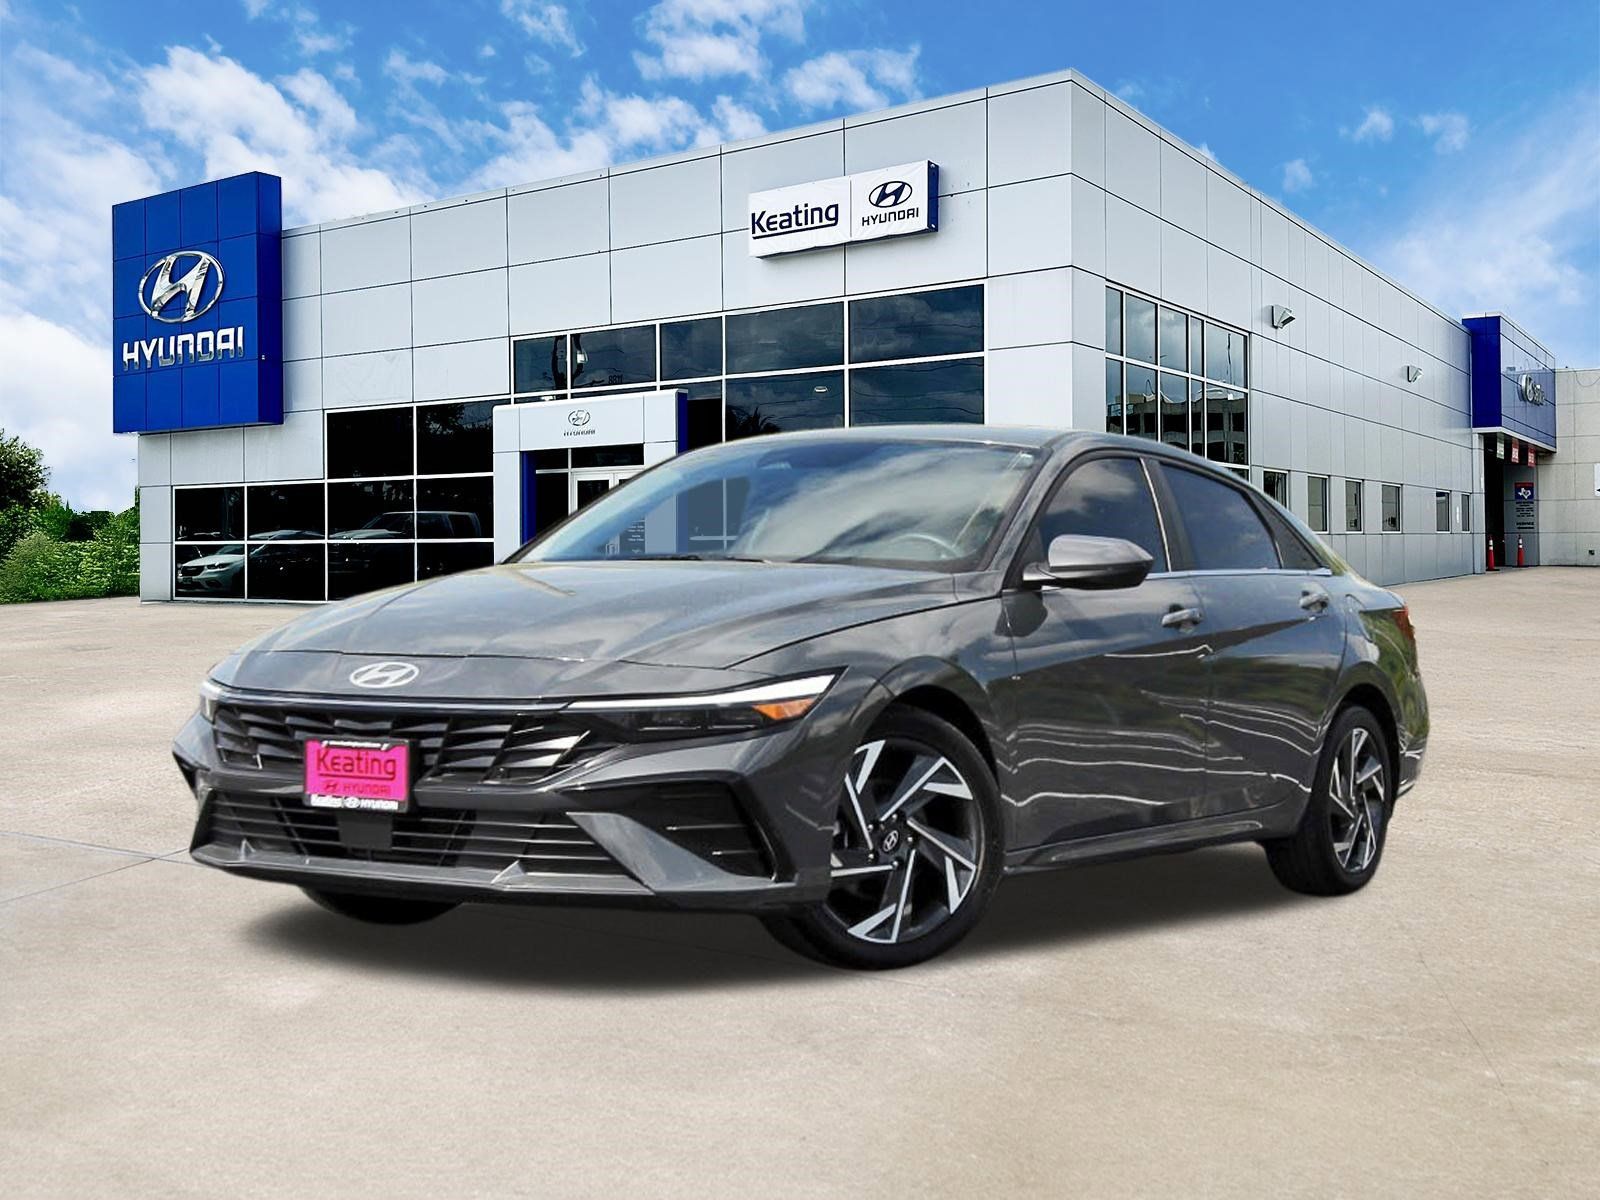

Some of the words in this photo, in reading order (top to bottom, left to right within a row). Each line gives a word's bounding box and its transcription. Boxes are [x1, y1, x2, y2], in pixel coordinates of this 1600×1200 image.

[751, 203, 839, 238] Keating
[862, 207, 919, 227] HYUNDAI
[122, 326, 244, 372] HYUNDAI
[316, 748, 397, 781] Keating
